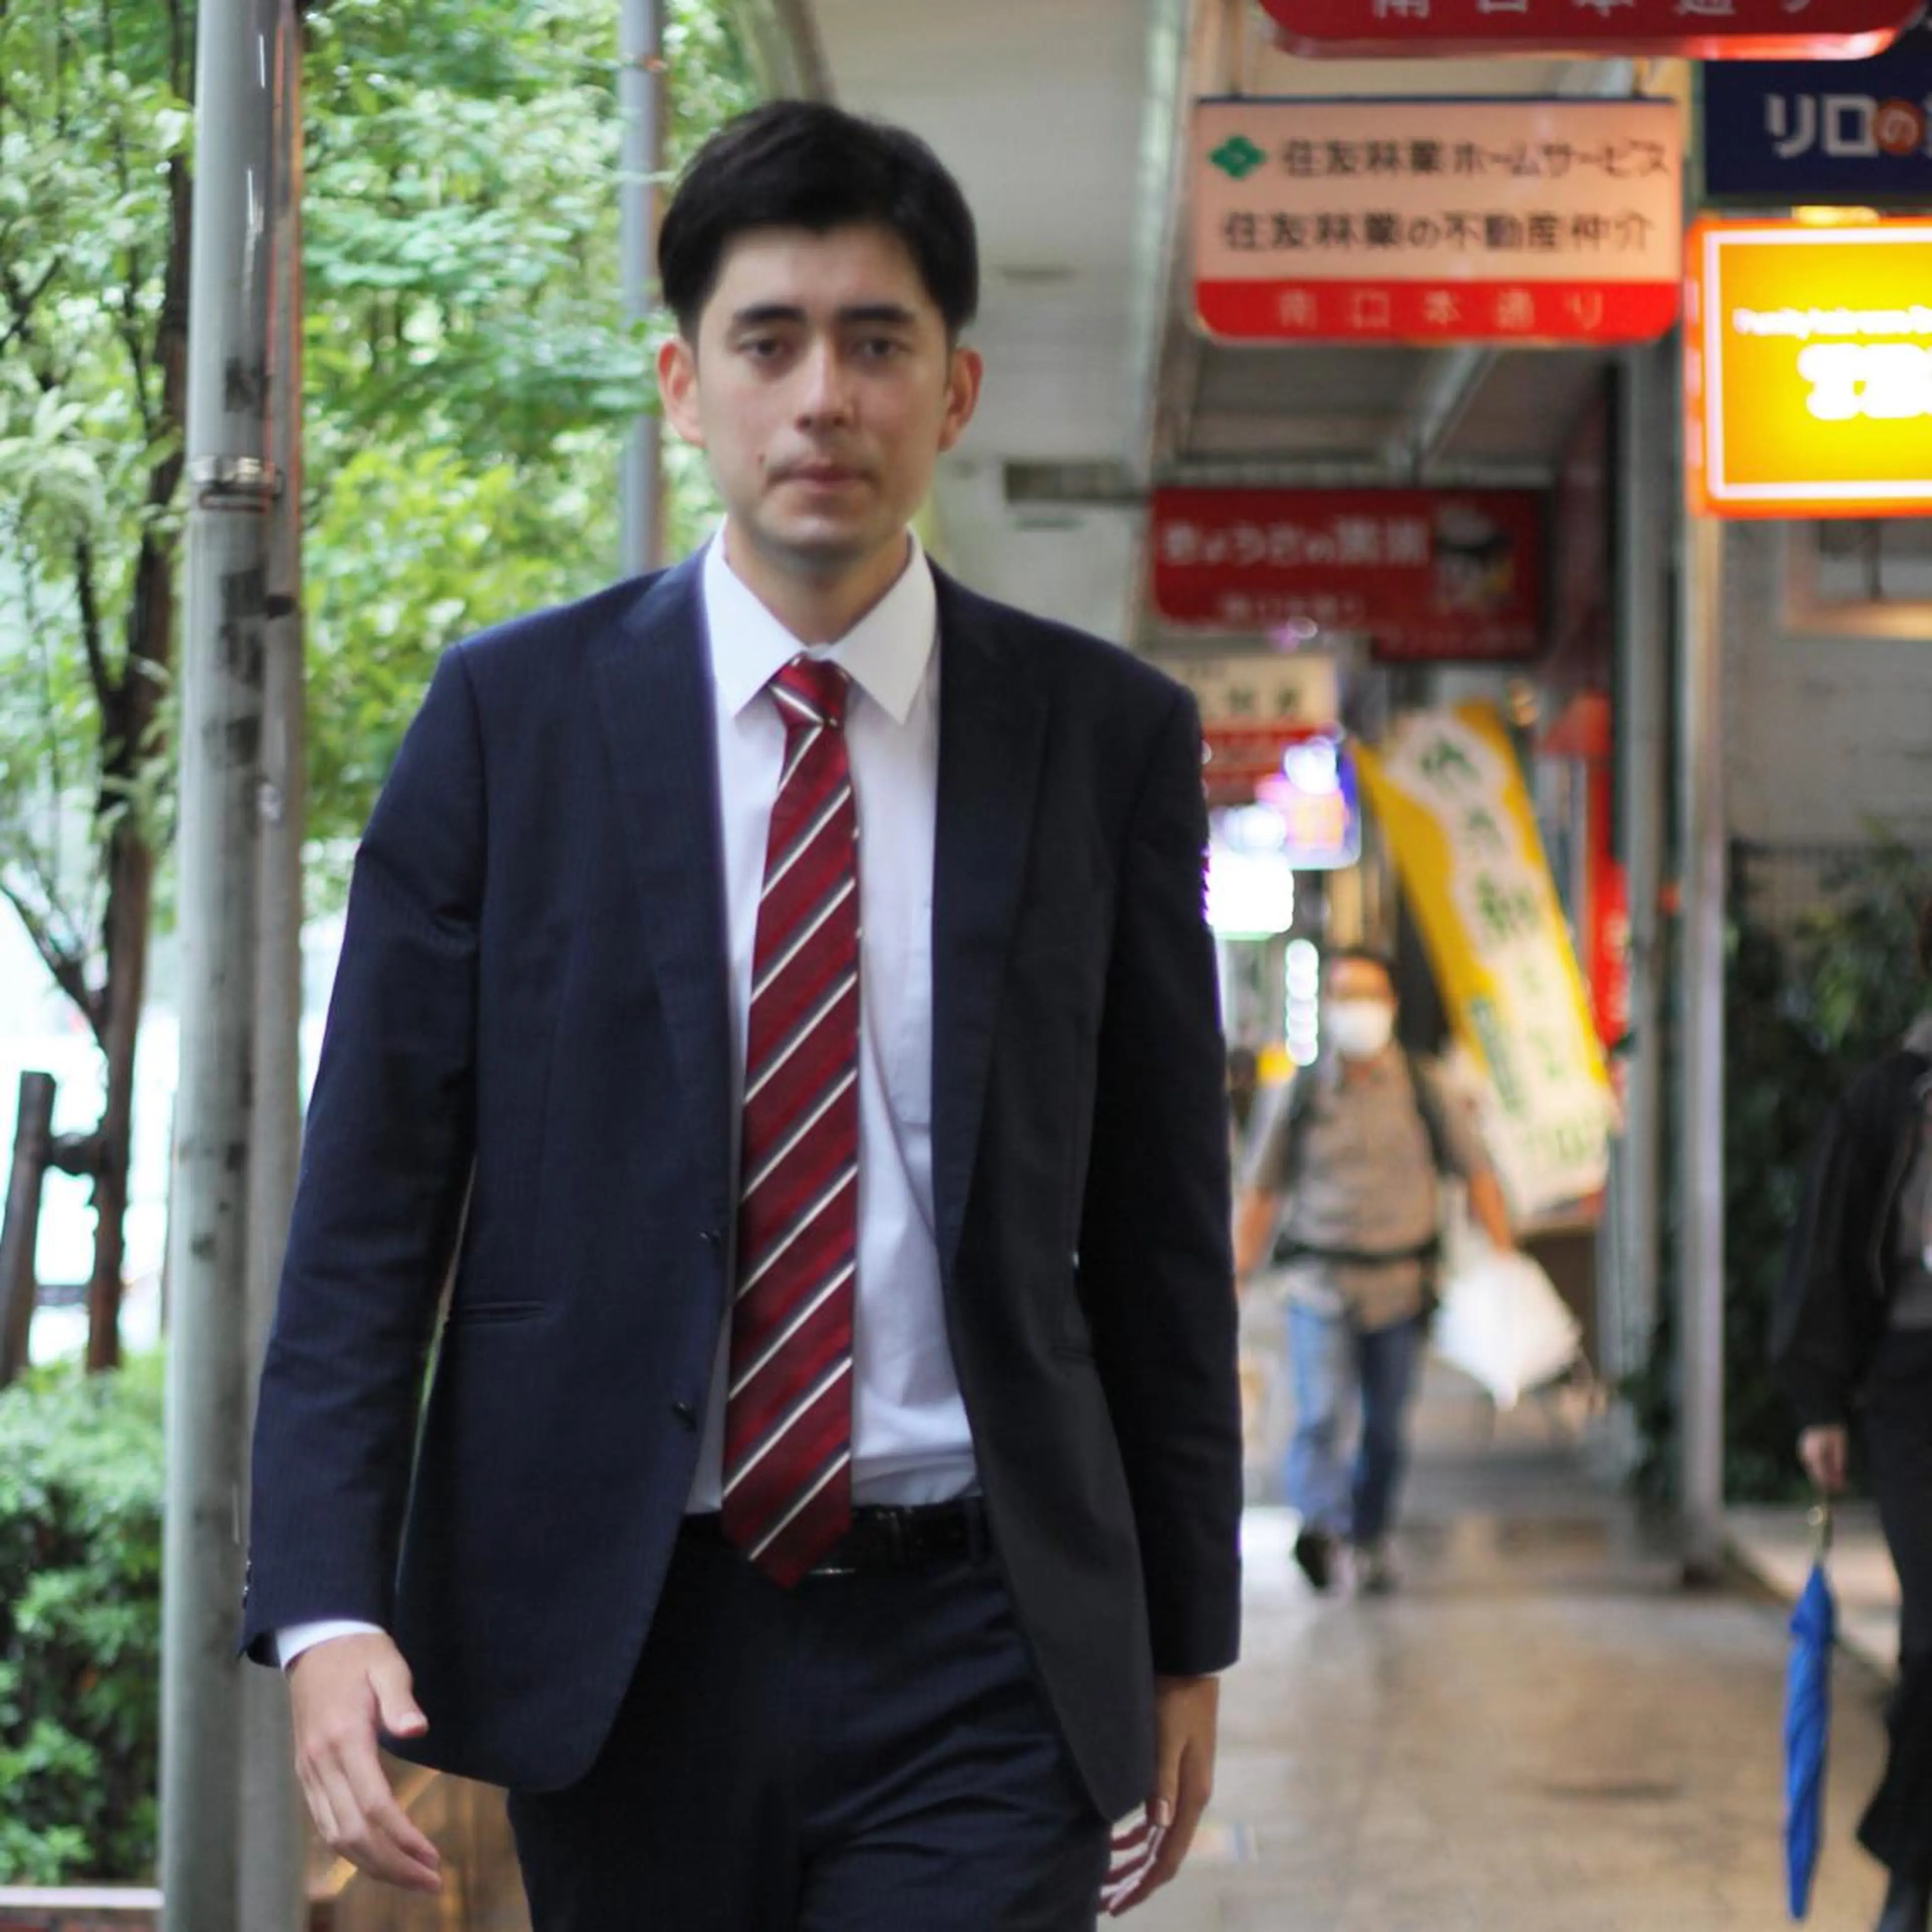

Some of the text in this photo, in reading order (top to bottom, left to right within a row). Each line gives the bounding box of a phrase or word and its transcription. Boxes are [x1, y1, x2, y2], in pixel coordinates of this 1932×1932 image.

[1765, 92, 1932, 159] リロの
[1281, 139, 1669, 178] 住友林業ホームサービス
[1223, 210, 1654, 251] 住友林業の不動産仲介
